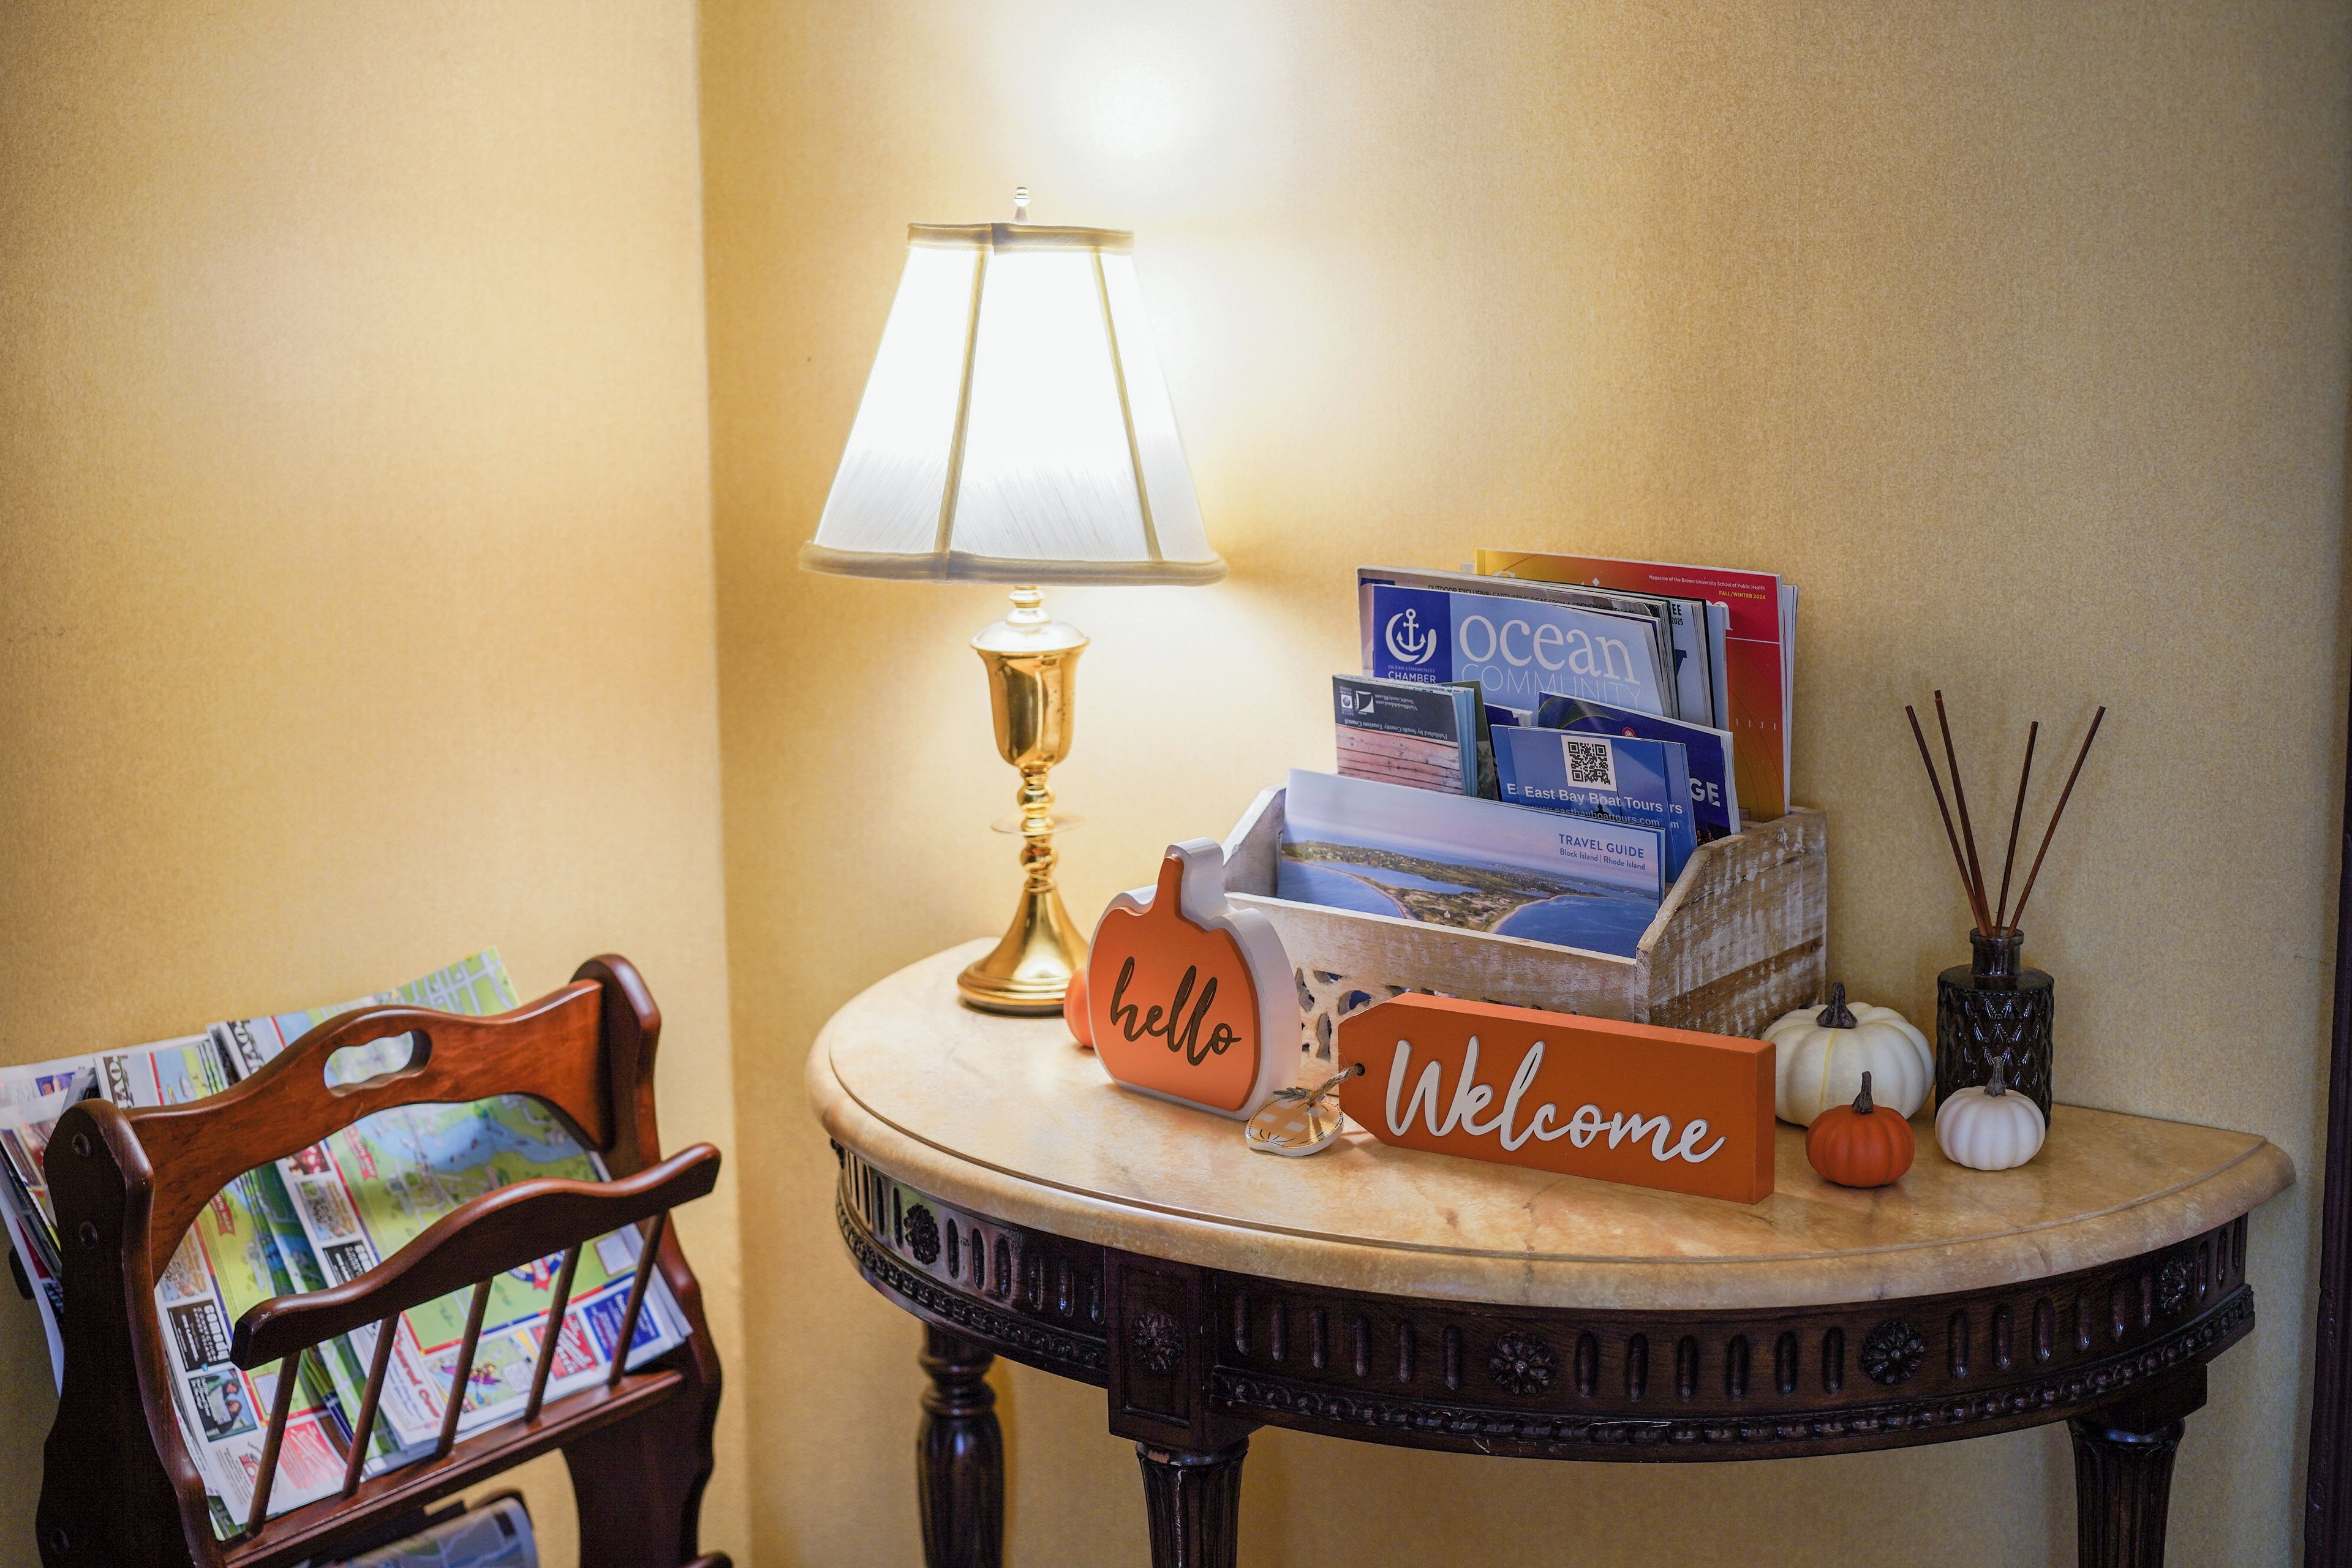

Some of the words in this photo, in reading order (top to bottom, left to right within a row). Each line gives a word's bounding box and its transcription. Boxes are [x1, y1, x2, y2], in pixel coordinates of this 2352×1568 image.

[1672, 617, 1683, 625] 2025
[1460, 614, 1640, 685] ocean
[1388, 671, 1436, 684] CHAMBER
[1461, 663, 1642, 710] COMMUNITY
[1363, 721, 1383, 729] Tourism
[1384, 723, 1402, 733] County
[1402, 726, 1417, 735] South
[1423, 729, 1447, 739] Published
[1525, 786, 1555, 800] East
[1559, 790, 1585, 806] Bay
[1589, 793, 1621, 807] Boat
[1624, 797, 1664, 813] Tours
[1528, 805, 1660, 827] eastbayboattours.com
[1559, 834, 1603, 851] TRAVEL
[1607, 843, 1645, 858] GUIDE
[1560, 848, 1578, 858] Block
[1580, 852, 1598, 861] Island
[1604, 856, 1624, 867] Rhode
[1626, 860, 1645, 870] Island
[1110, 956, 1242, 1066] hello
[1385, 1035, 1727, 1163] Welcome
